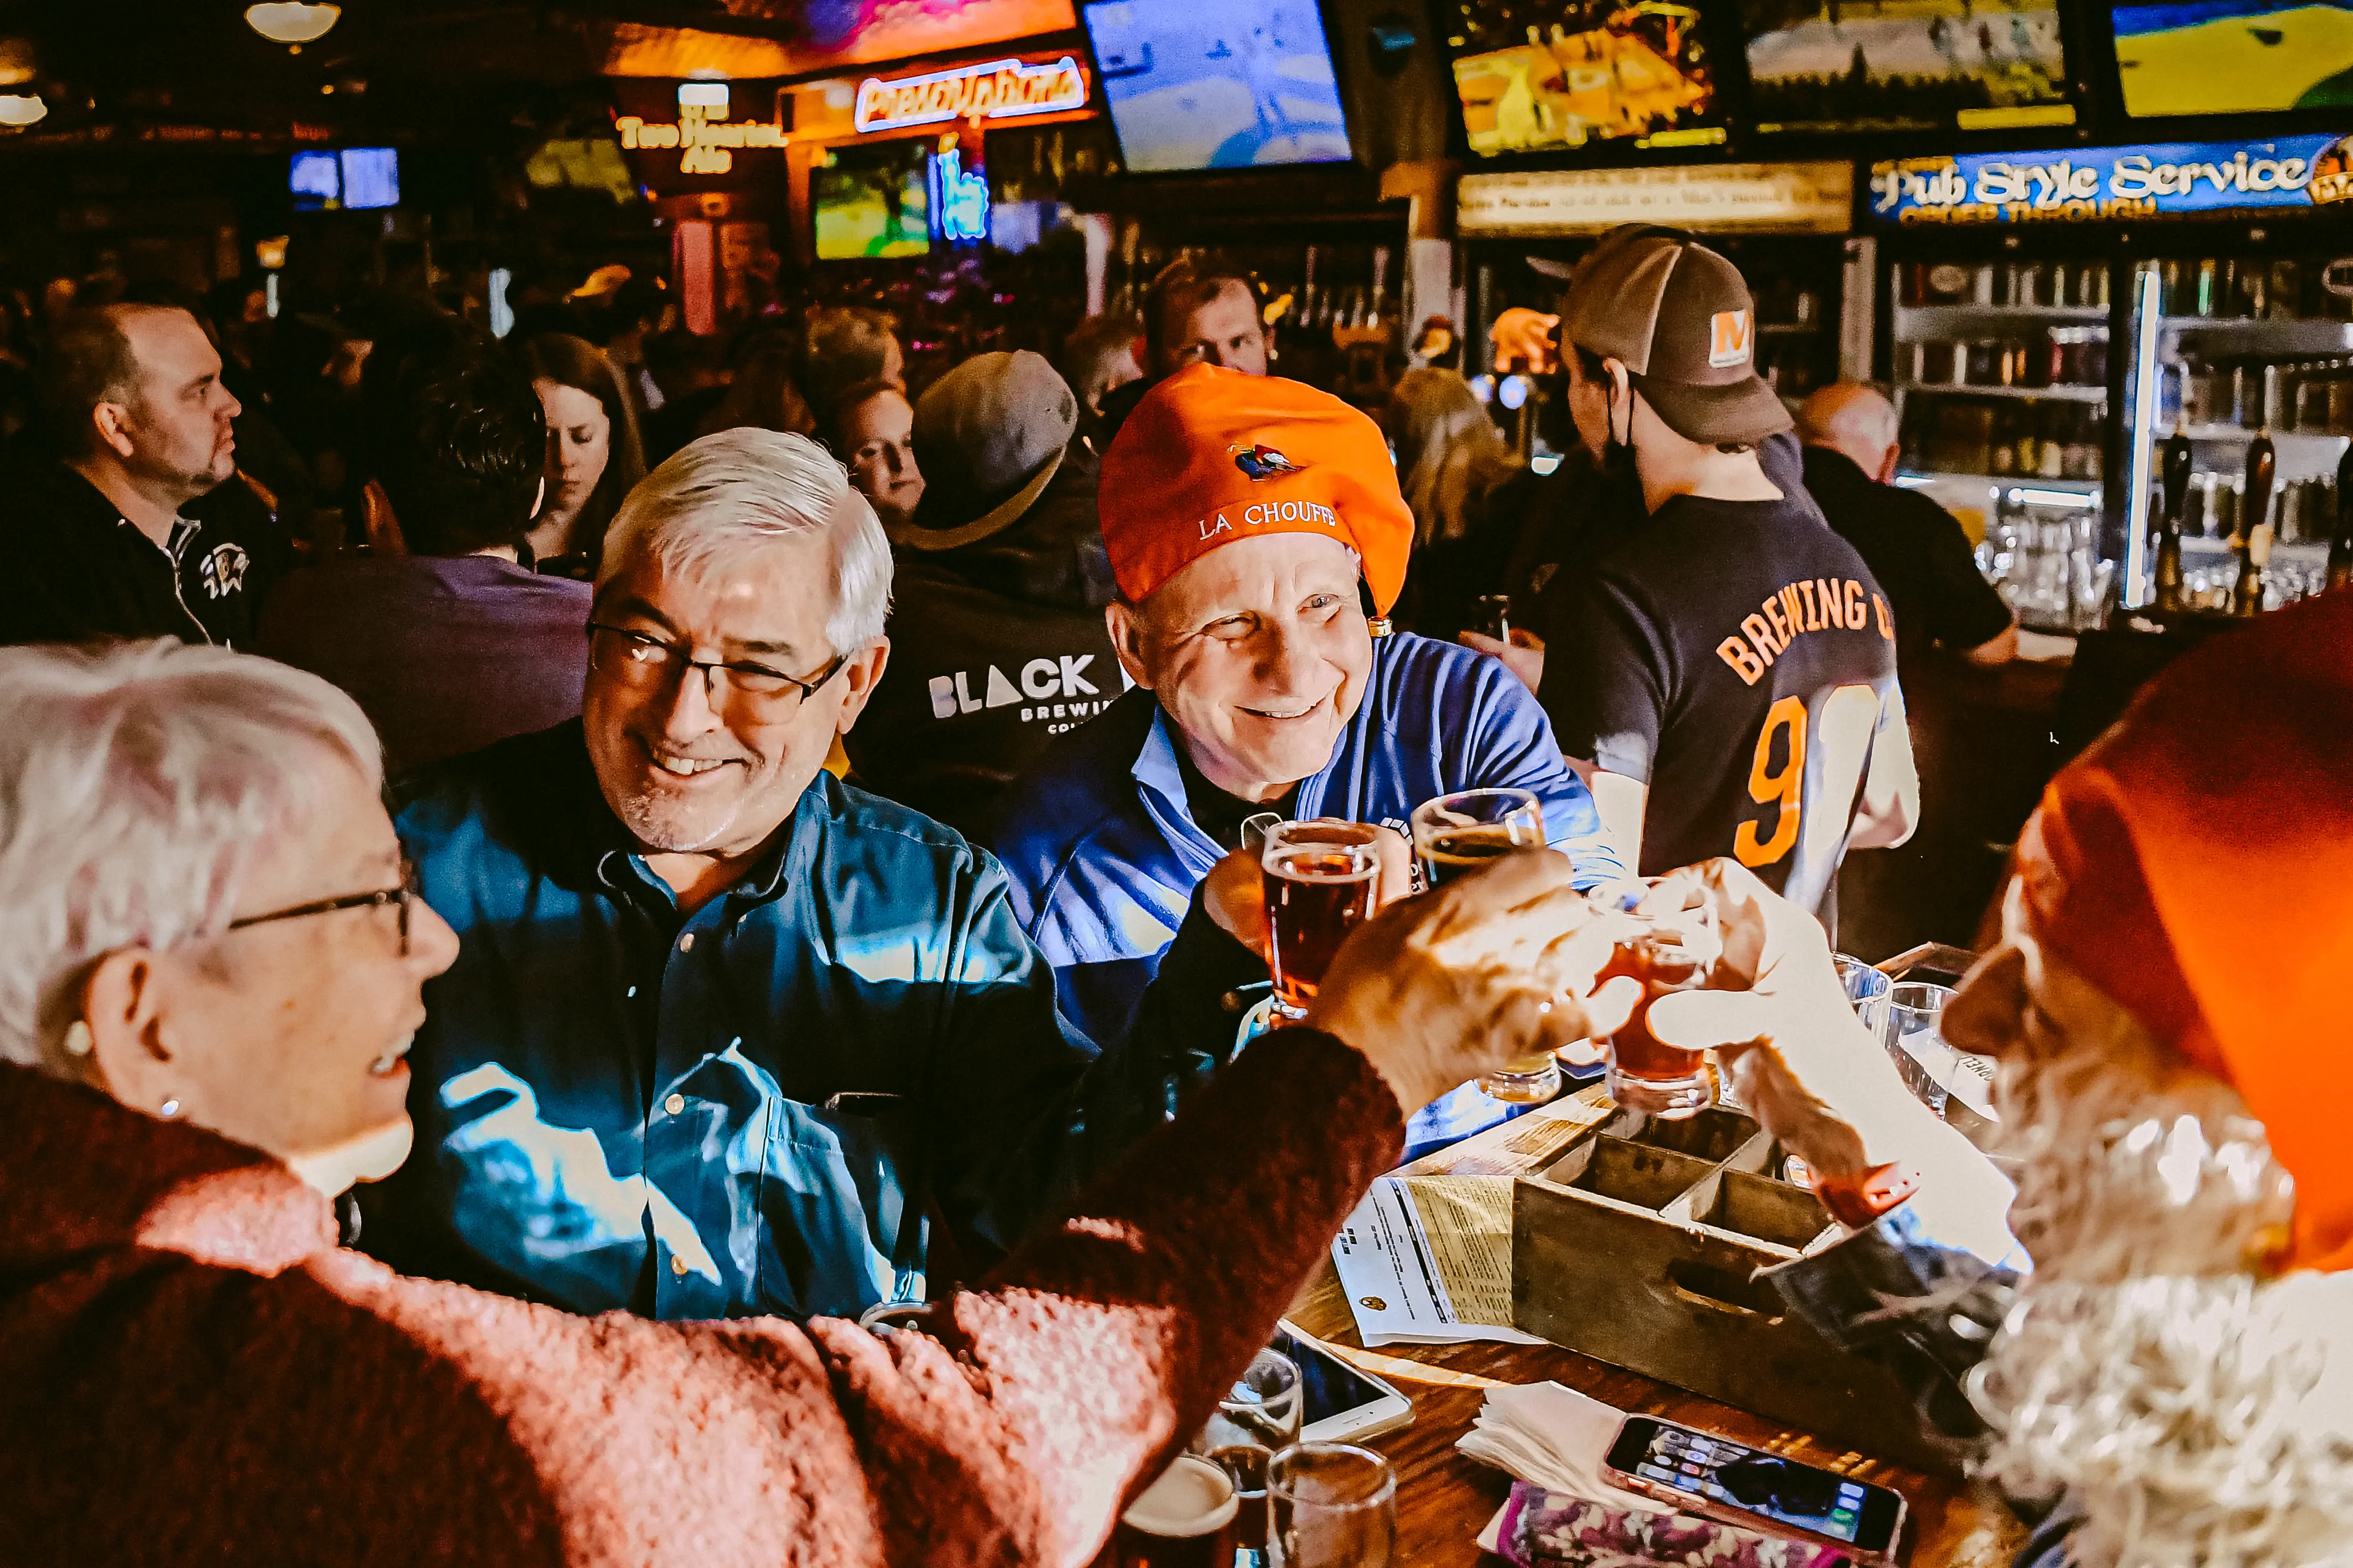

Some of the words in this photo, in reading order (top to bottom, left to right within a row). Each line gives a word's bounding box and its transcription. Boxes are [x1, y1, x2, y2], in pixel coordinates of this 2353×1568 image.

[1871, 162, 1967, 213] Pub
[2109, 151, 2312, 199] Service
[1199, 513, 1233, 541] LA
[1243, 501, 1337, 527] CHOUFFE
[1716, 577, 1867, 686] BREWING
[928, 654, 1100, 718] BLACK
